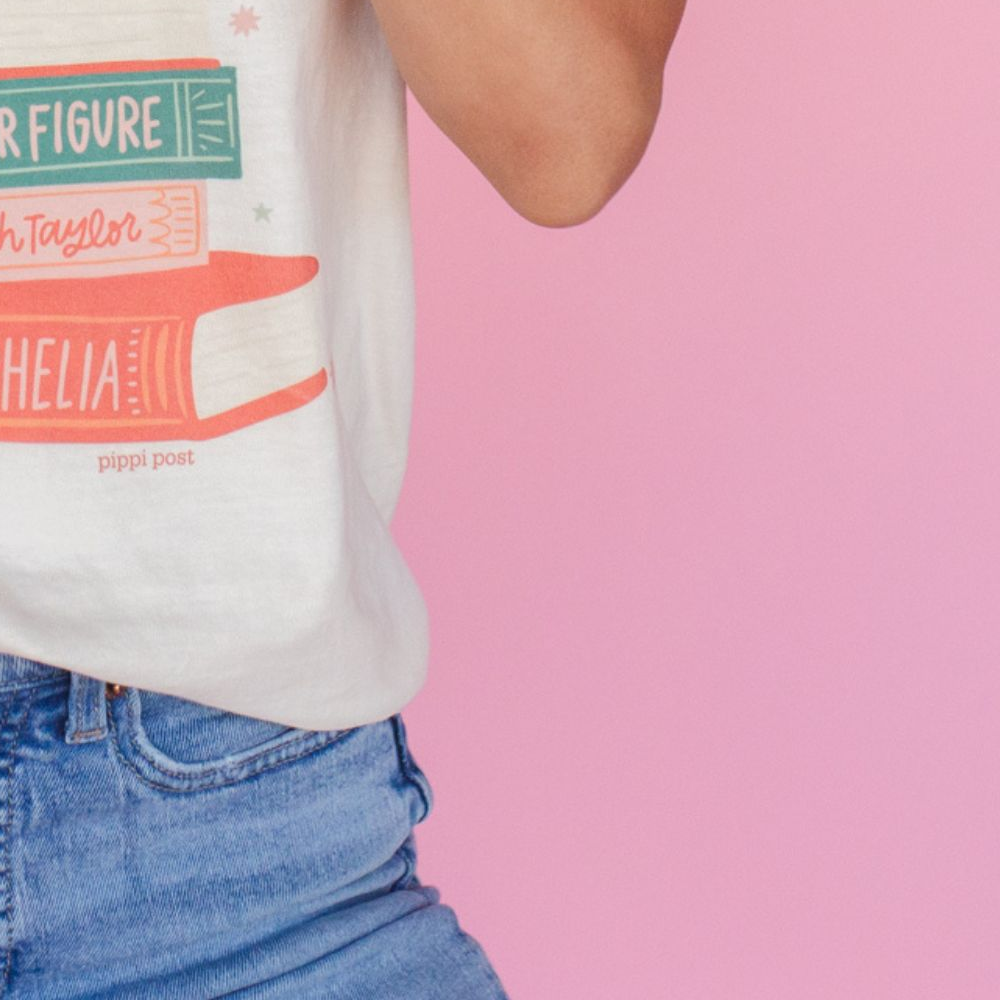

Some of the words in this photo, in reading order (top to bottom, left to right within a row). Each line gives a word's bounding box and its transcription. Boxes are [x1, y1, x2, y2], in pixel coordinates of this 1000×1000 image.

[27, 96, 163, 162] FIGURE
[25, 209, 142, 258] Taylor
[97, 452, 147, 473] pippi
[152, 449, 195, 467] post
